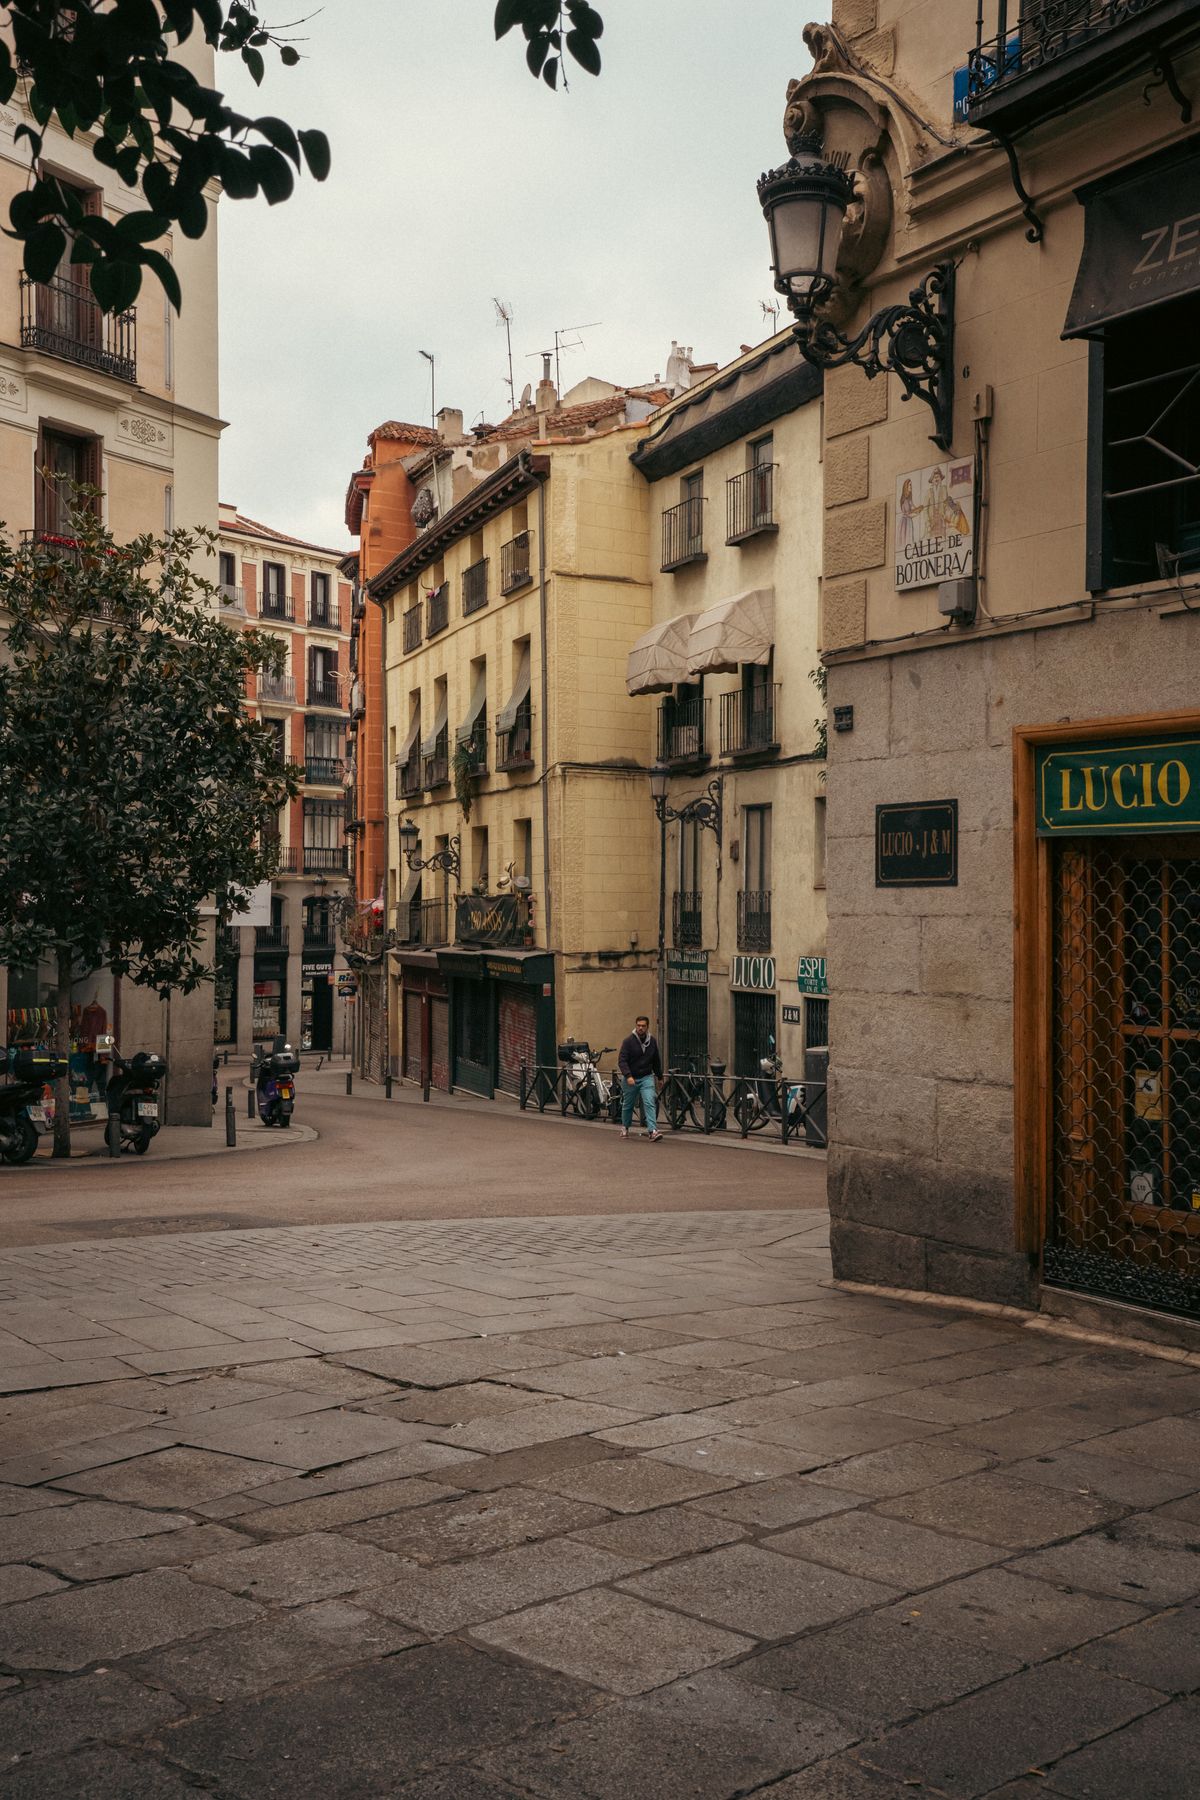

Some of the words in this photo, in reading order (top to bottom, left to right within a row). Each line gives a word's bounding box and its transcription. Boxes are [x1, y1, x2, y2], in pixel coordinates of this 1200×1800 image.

[1132, 212, 1200, 274] ZE
[962, 365, 970, 379] 6
[904, 535, 943, 560] CALLE
[948, 533, 963, 549] DE
[895, 549, 973, 586] BOTONERAS
[1059, 759, 1191, 812] LUCIO
[881, 831, 914, 858] LUCIO
[316, 963, 332, 971] GUYS
[732, 956, 775, 990] LUCIO
[798, 957, 827, 979] ESPU
[253, 1018, 276, 1028] GUYS
